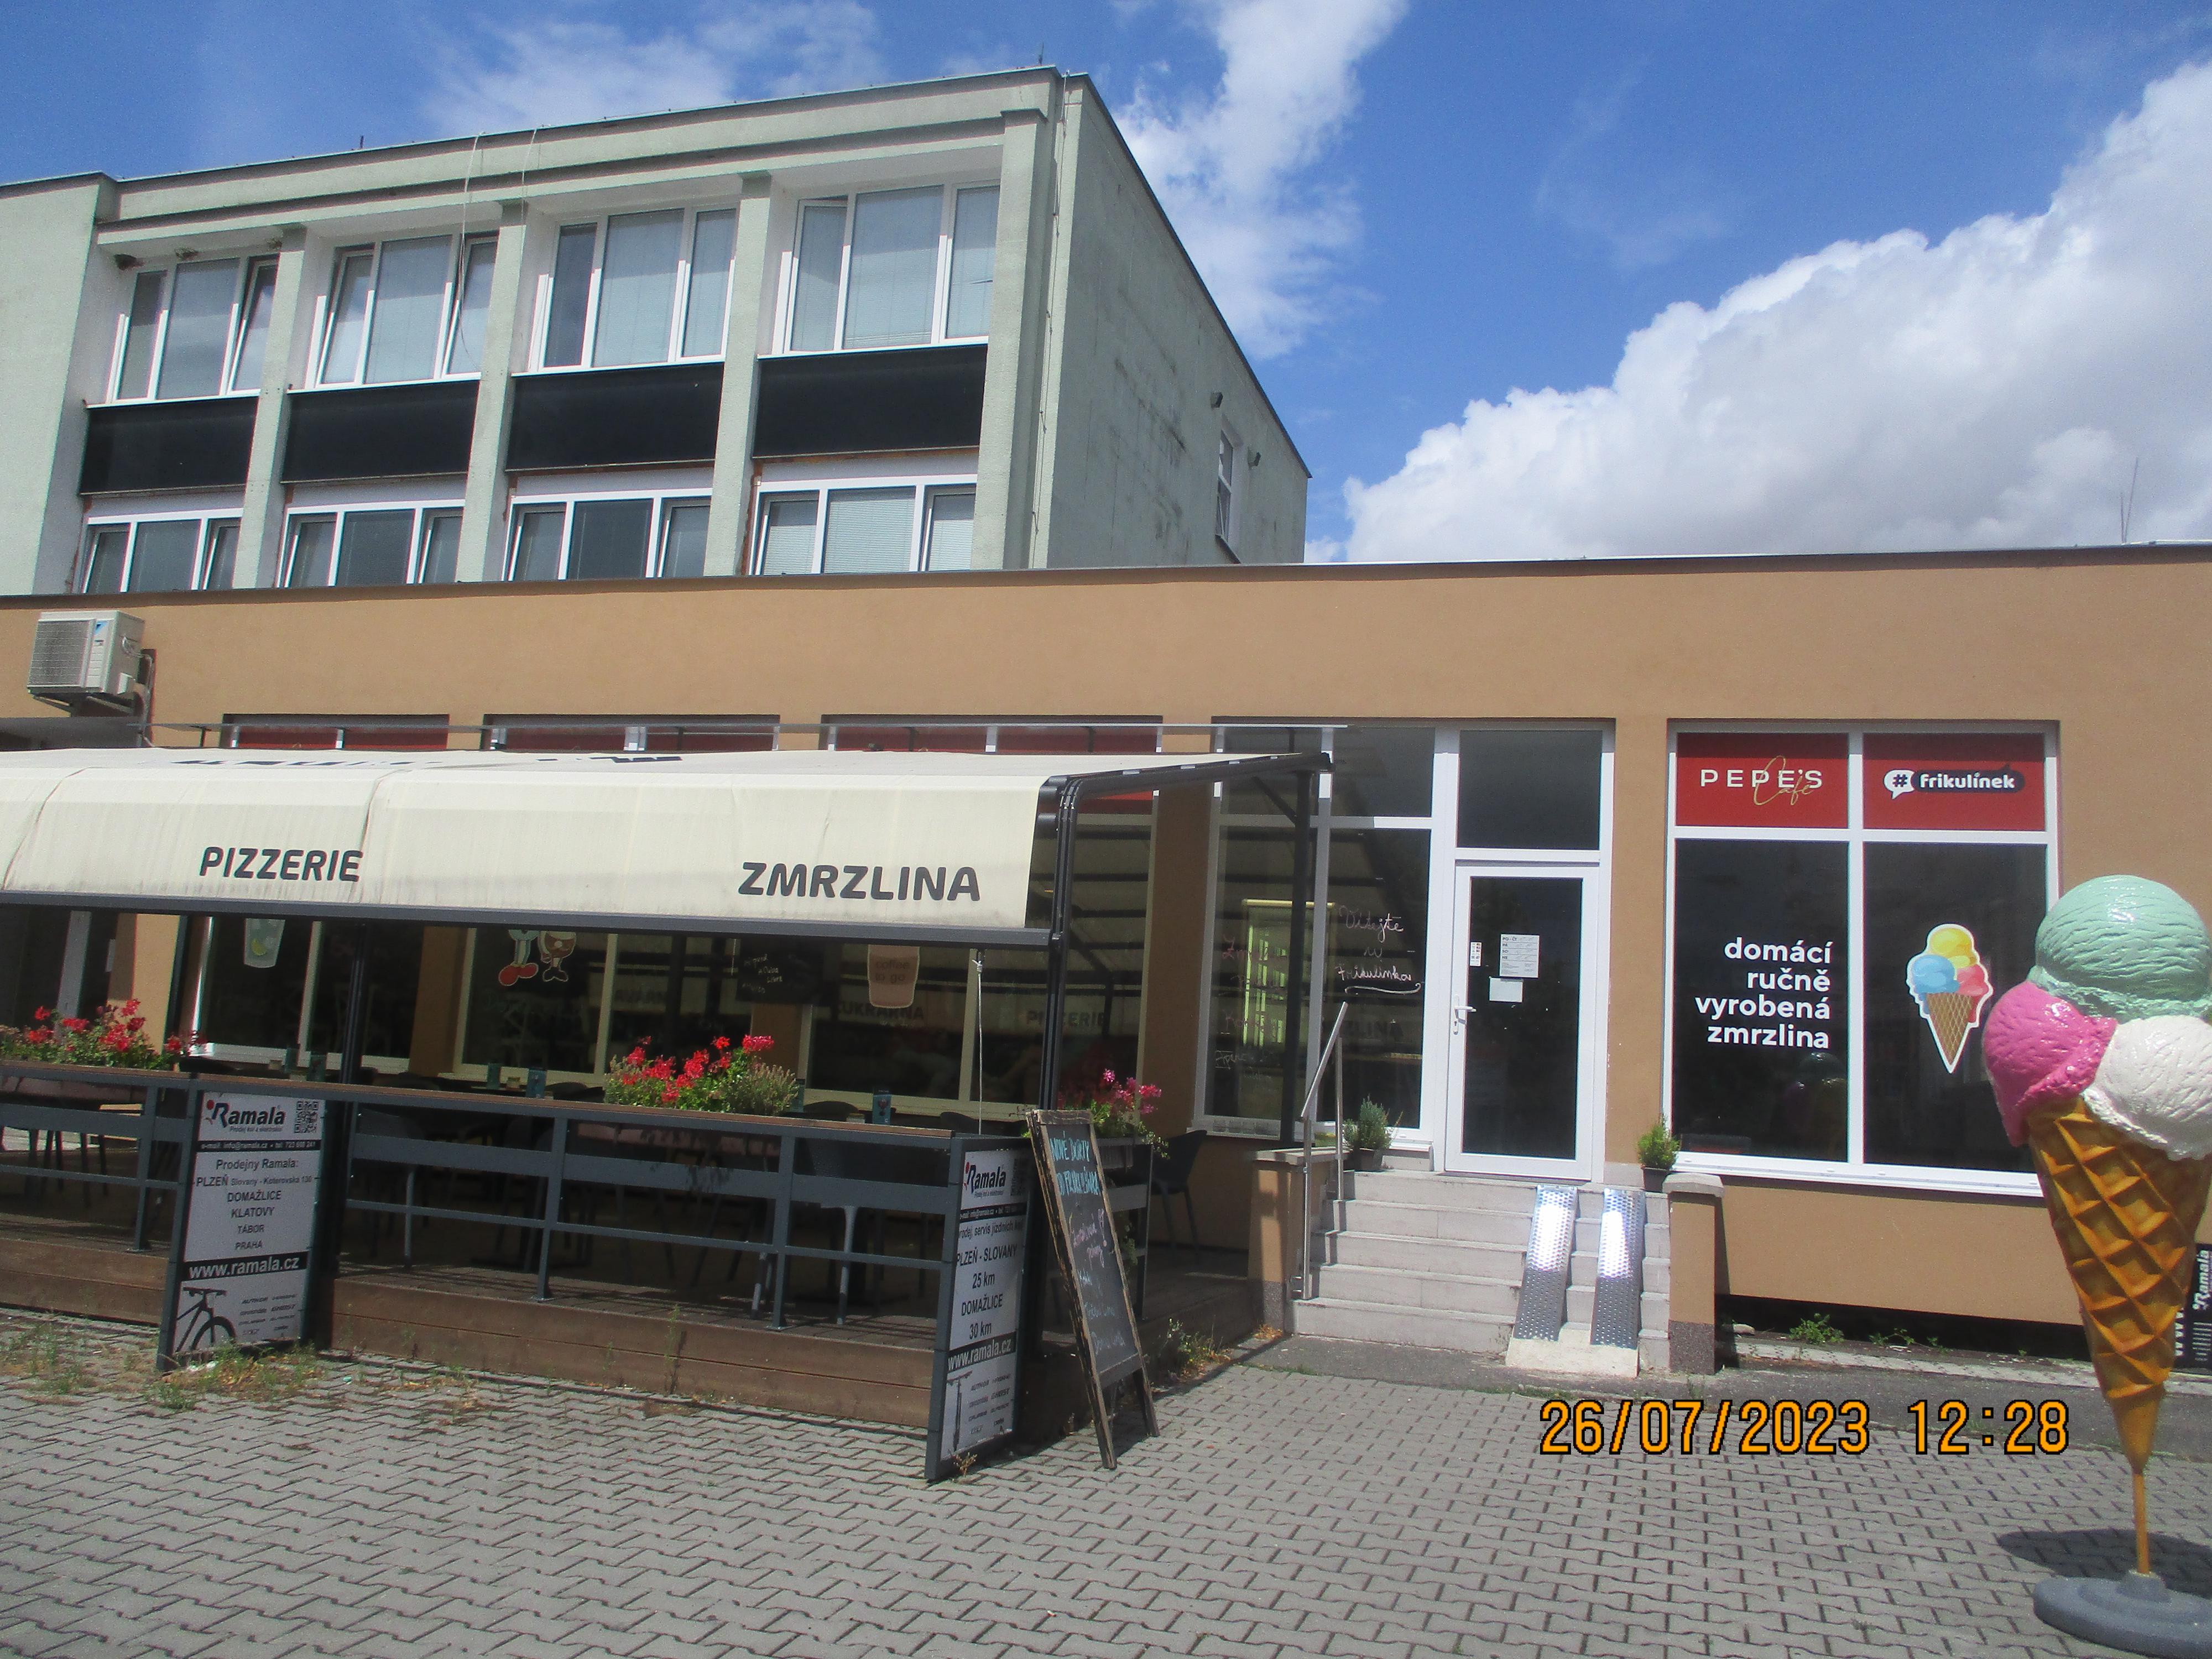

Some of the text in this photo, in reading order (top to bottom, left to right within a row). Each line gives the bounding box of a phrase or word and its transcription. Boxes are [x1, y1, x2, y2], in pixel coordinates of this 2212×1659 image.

[1700, 769, 1823, 789] PEPE'S
[1920, 771, 2015, 789] frikulínek
[200, 847, 363, 883] PIZZERIE
[738, 862, 980, 901] ZMRZLINA
[1724, 937, 1834, 964] domácí
[875, 959, 910, 969] coffee
[1747, 967, 1830, 992] ručně
[1695, 994, 1830, 1020] vyrobená
[1707, 1024, 1829, 1048] zmrzlina
[216, 1159, 259, 1171] Prodejny
[196, 1175, 228, 1187] PLZEŇ
[227, 1190, 281, 1202] DOMAŽLICE
[231, 1207, 275, 1218] KLATOVY
[974, 1223, 990, 1236] servis
[235, 1240, 263, 1250] PRAHA
[983, 1244, 1018, 1261] SLOVANY
[189, 1256, 300, 1279] www.ramala.cz
[972, 1271, 995, 1288] 25 km
[961, 1293, 1003, 1316] DOMAŽLICE
[969, 1321, 992, 1339] 30 km
[947, 1338, 1011, 1371] www.ramala.cz
